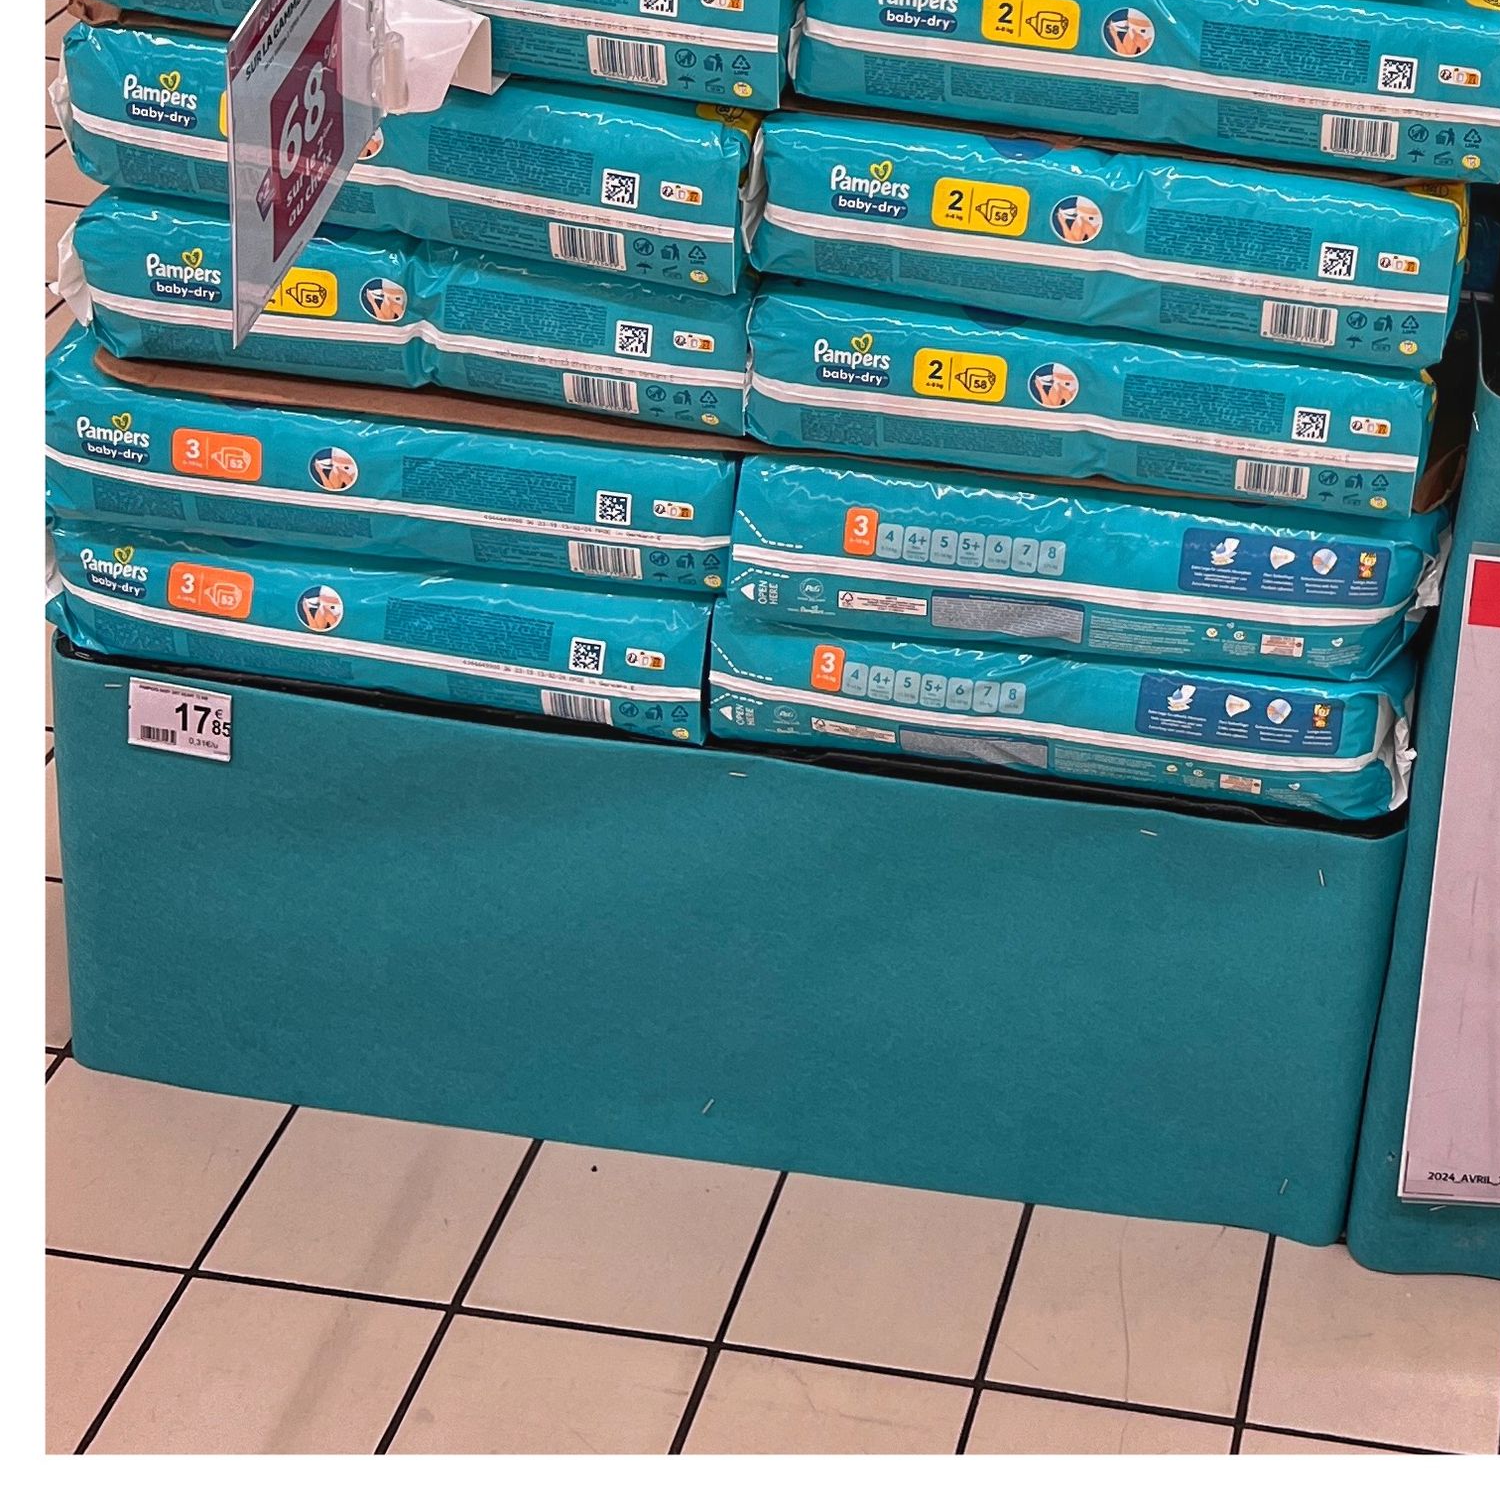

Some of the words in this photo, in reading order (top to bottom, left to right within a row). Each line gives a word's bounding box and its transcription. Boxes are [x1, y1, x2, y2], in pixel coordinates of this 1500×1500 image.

[245, 51, 261, 81] SUR
[262, 38, 272, 56] LA
[830, 164, 910, 199] Pampers
[838, 195, 900, 215] baby-dry
[948, 190, 964, 212] 2
[994, 211, 1009, 223] 58
[77, 416, 150, 448] Pampers
[87, 443, 143, 462] baby-dry
[185, 439, 200, 459] 3
[853, 515, 869, 537] 3
[885, 530, 895, 542] 4
[908, 533, 927, 547] 4+
[939, 536, 949, 548] 5
[962, 538, 980, 551] 5+
[994, 541, 1004, 553] 6
[1023, 544, 1031, 556] 7
[1048, 547, 1057, 560] 8
[757, 580, 767, 605] OPEN
[769, 583, 778, 605] HERE
